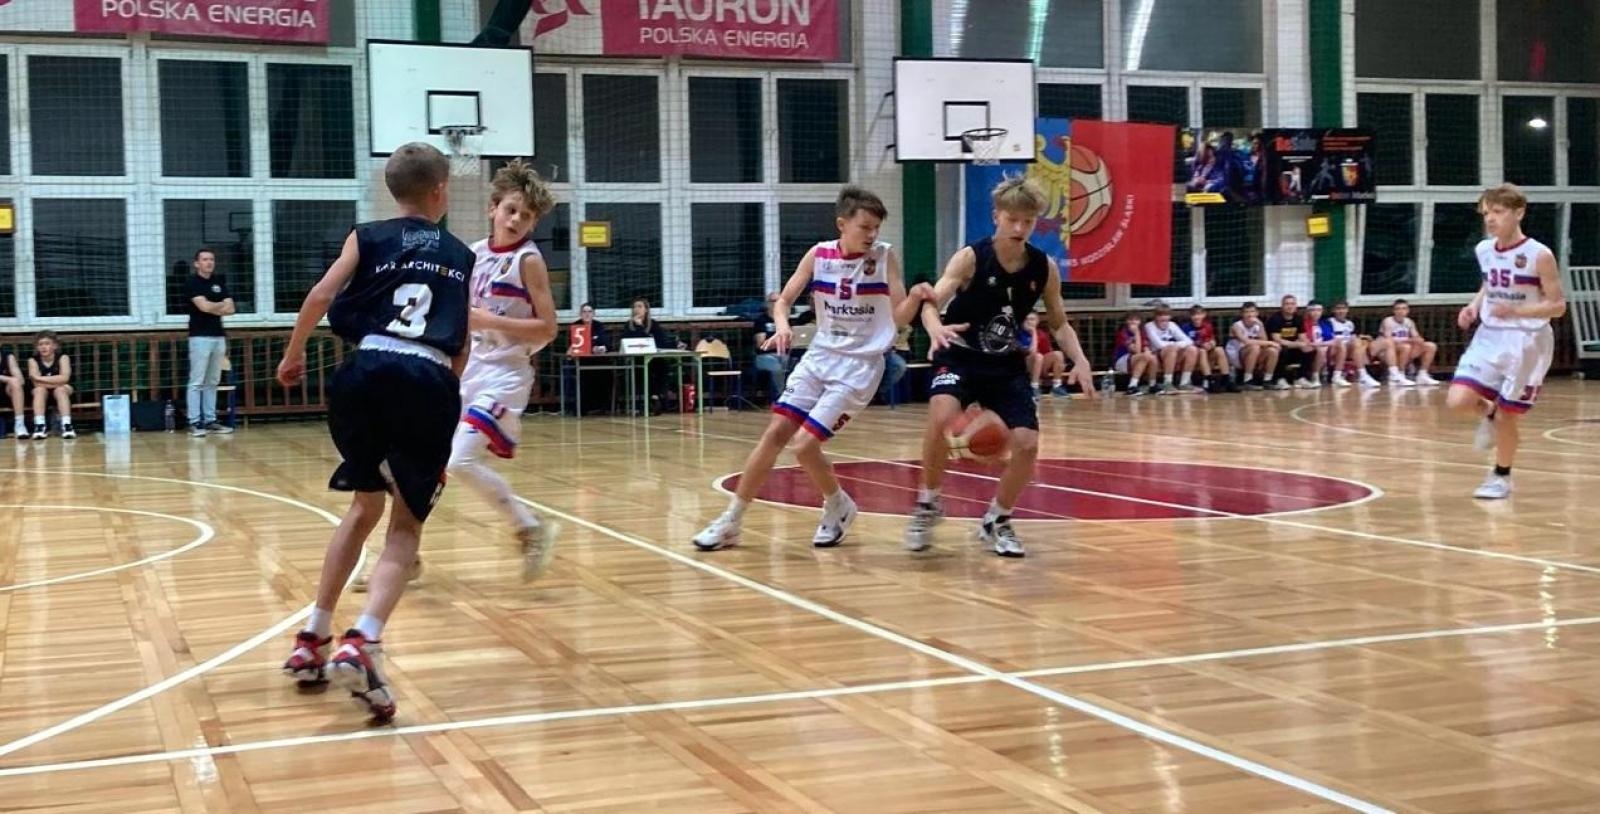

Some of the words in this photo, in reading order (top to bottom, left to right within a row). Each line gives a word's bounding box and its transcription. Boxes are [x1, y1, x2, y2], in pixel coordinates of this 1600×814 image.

[102, 0, 200, 21] POLSKA
[208, 6, 317, 28] ENERGIA
[638, 0, 811, 26] TAURON
[639, 27, 718, 45] POLSKA
[723, 30, 809, 49] ENERGIA
[401, 260, 465, 282] ARCHITEKCI
[1490, 267, 1511, 288] 35
[839, 277, 853, 300] 5
[385, 282, 434, 338] 3
[571, 327, 585, 348] 5
